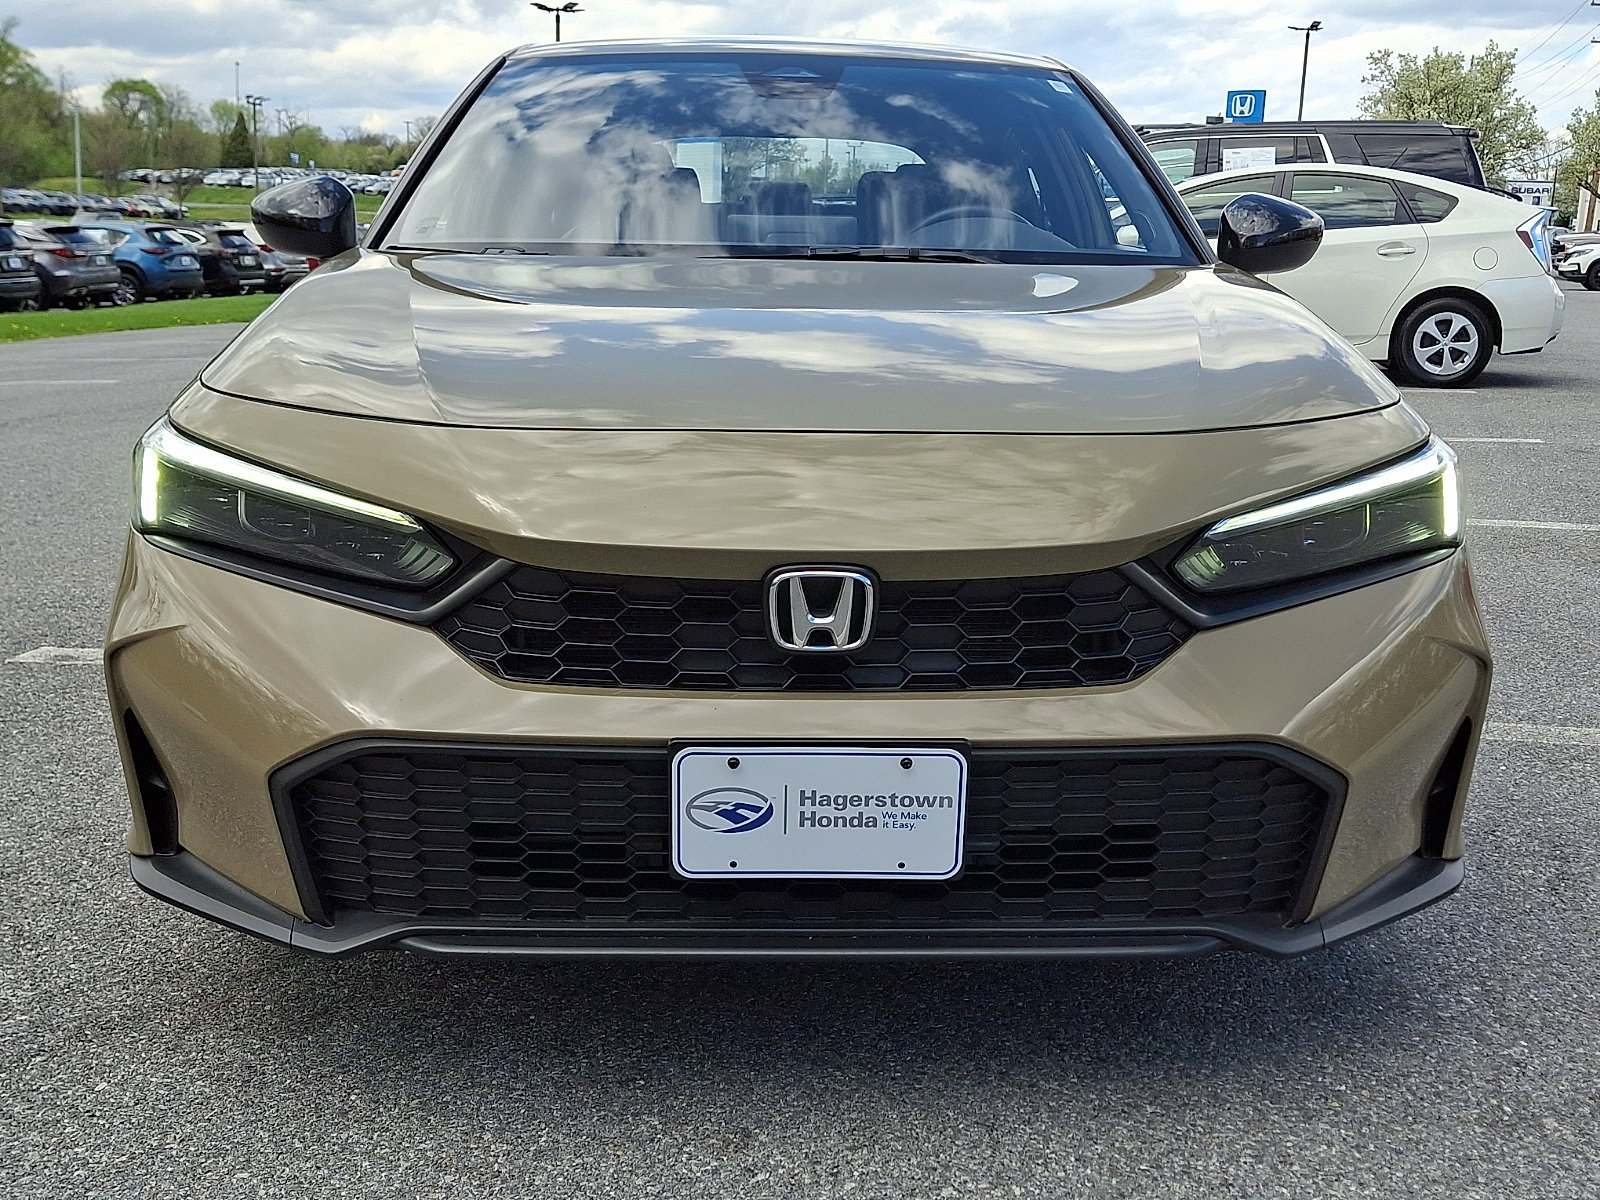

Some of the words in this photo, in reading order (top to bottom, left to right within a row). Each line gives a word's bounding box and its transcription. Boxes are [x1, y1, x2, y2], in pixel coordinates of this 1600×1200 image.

[1511, 187, 1552, 195] SUBAR
[799, 789, 954, 811] Hagerstown
[799, 810, 878, 829] Honda
[881, 811, 898, 820] We
[900, 811, 928, 821] Make
[882, 820, 890, 829] it
[892, 820, 917, 832] Easy.
